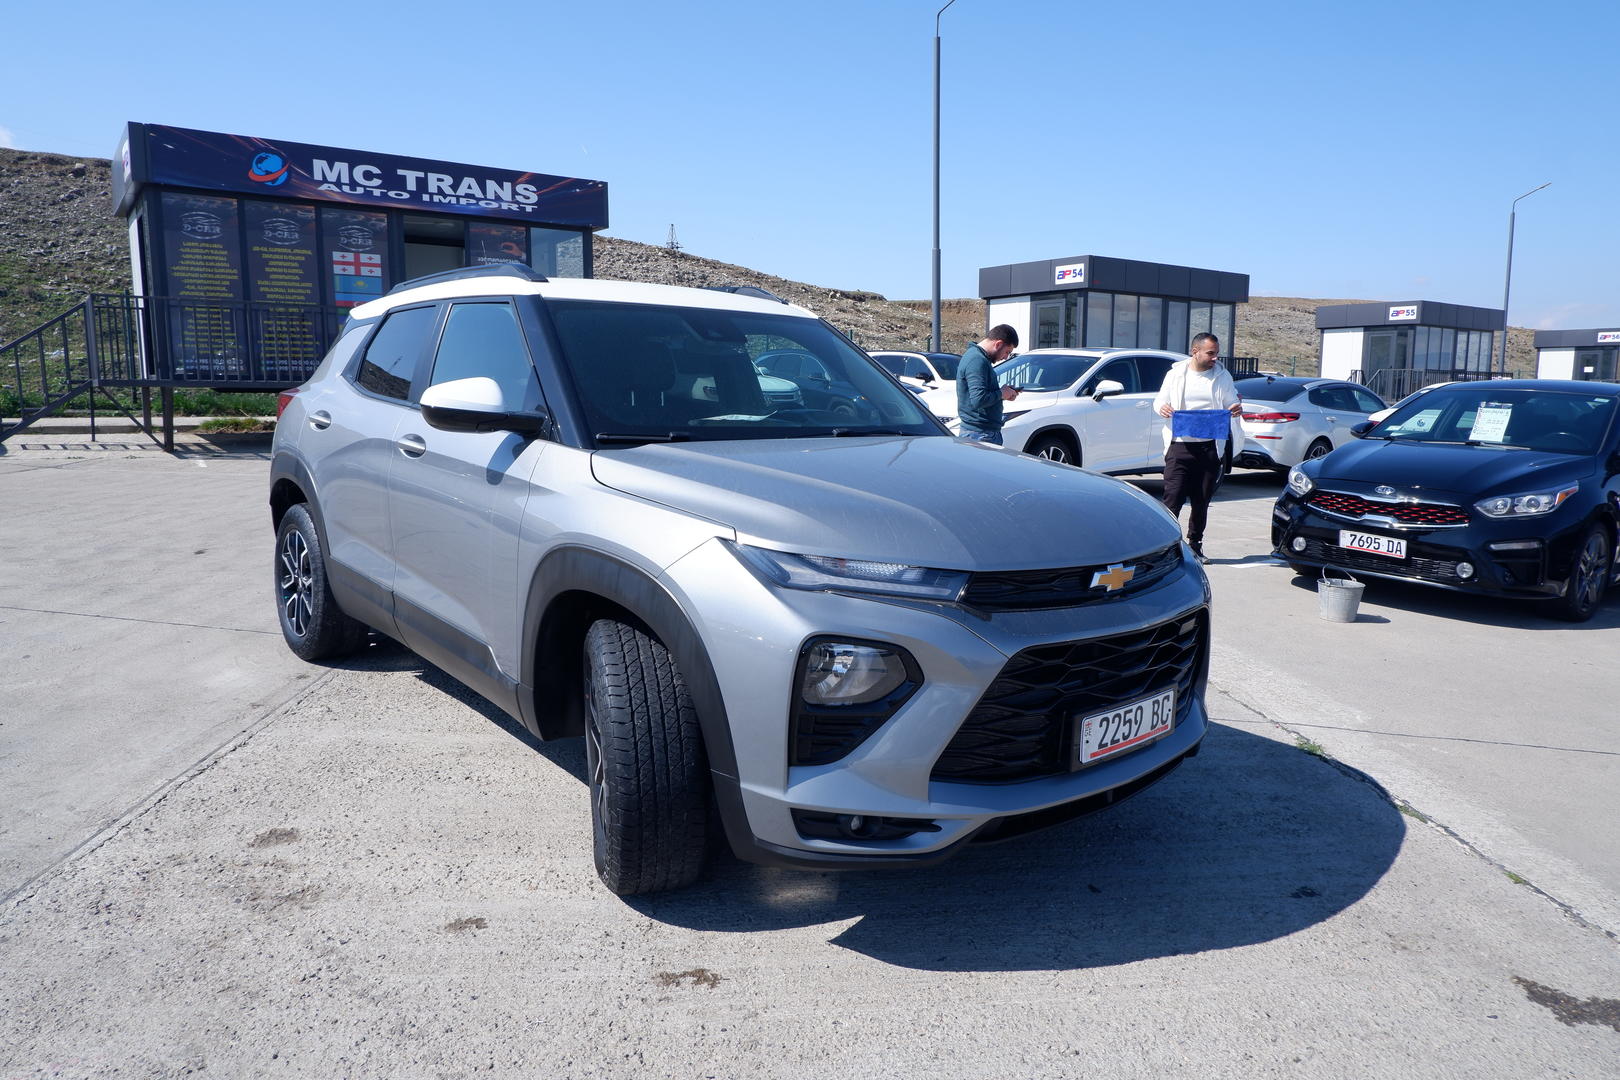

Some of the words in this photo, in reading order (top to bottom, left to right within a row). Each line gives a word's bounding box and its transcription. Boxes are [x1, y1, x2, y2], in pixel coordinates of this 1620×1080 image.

[312, 158, 383, 187] MC
[397, 169, 539, 204] TRANS
[317, 183, 411, 200] AUTO
[423, 193, 538, 213] IMPORT
[1072, 268, 1083, 278] 54
[1349, 533, 1381, 550] 7695
[1387, 539, 1403, 554] DA
[1098, 705, 1144, 750] 2259
[1150, 694, 1170, 731] BC
